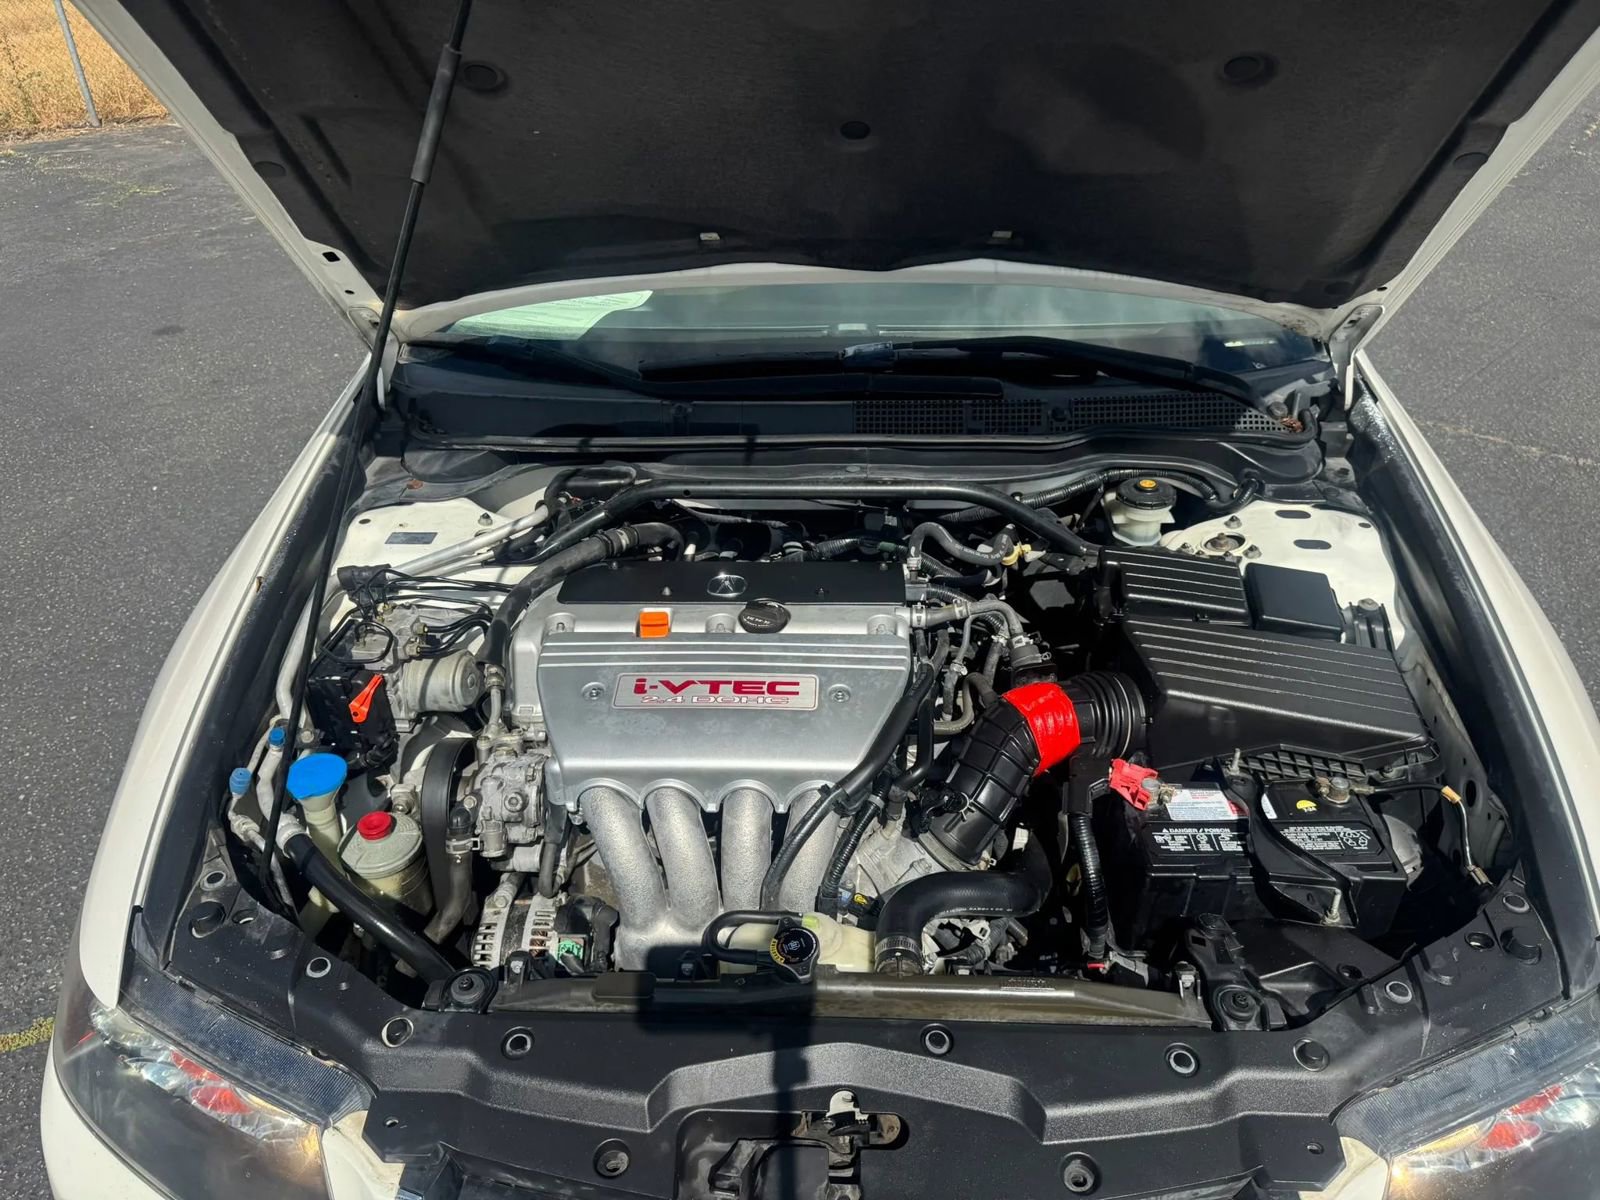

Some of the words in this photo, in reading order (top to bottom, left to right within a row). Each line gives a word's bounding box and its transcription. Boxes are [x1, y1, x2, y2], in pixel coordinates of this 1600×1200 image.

[633, 678, 800, 696] i-VTEC
[642, 696, 684, 704] 2.4
[691, 696, 790, 704] DOHC
